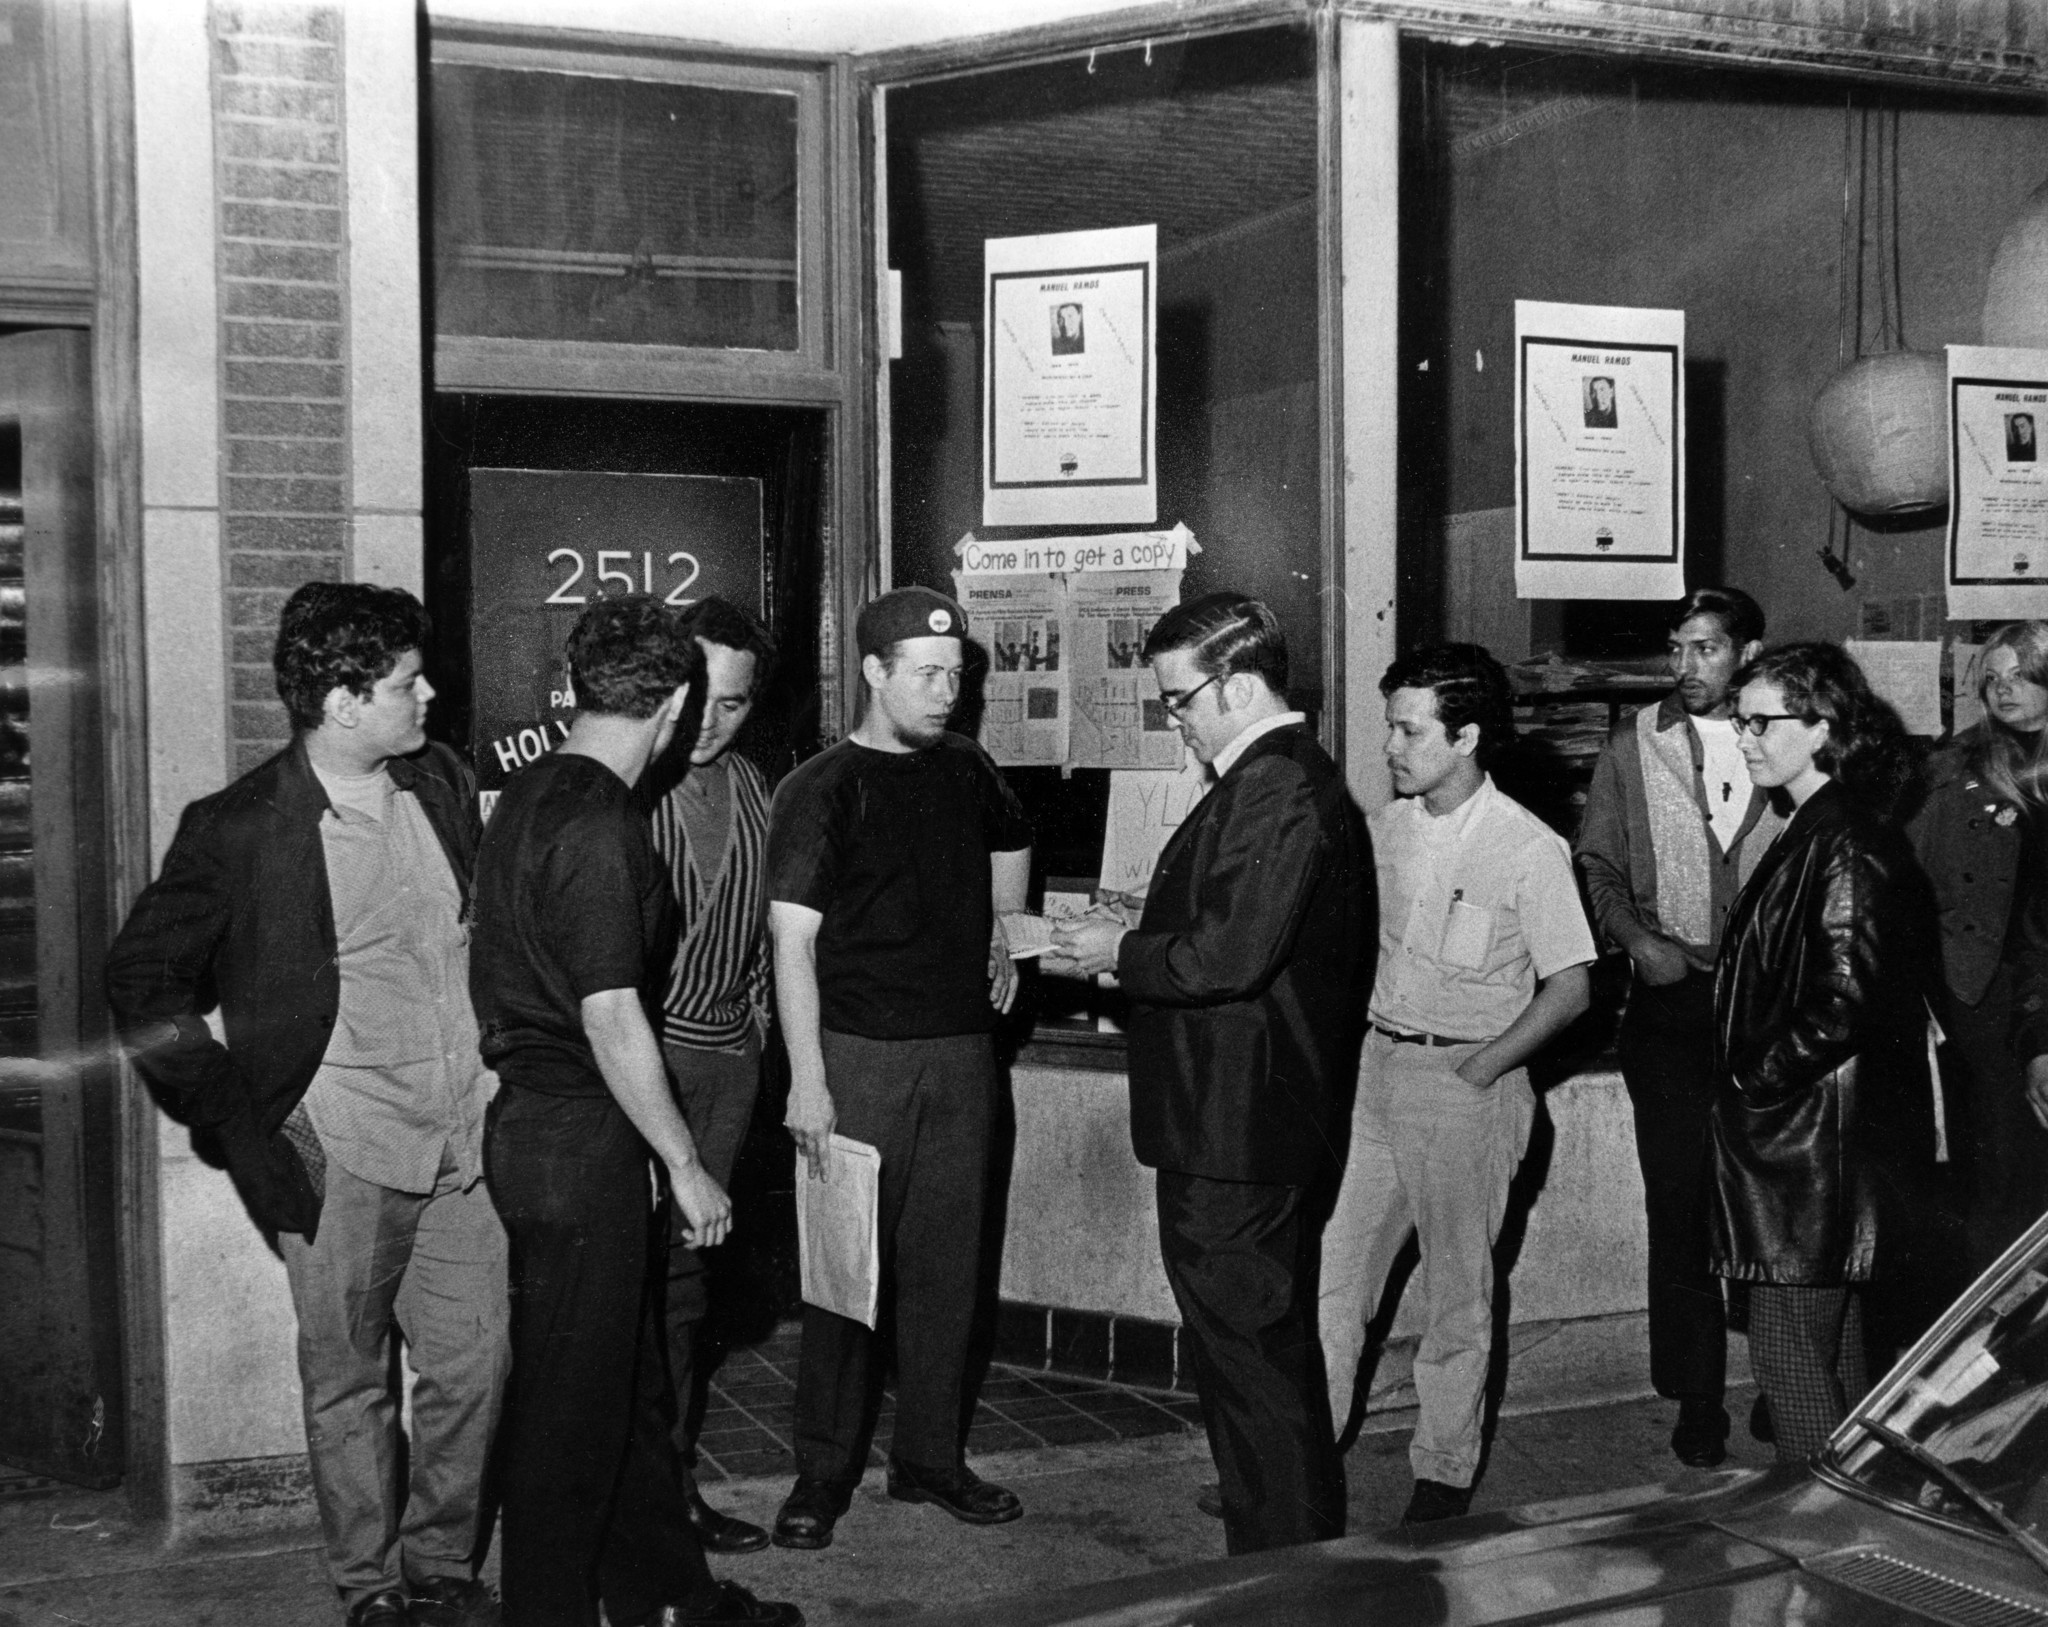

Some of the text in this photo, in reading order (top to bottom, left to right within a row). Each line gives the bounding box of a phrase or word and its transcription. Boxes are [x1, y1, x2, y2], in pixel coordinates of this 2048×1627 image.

[1040, 280, 1099, 291] MANUEL RAMOS
[1571, 354, 1631, 365] MANUEL RAMOS
[1995, 393, 2047, 403] MANUEL RAMOS
[966, 544, 1017, 571] Come
[1073, 546, 1106, 573] get
[1113, 549, 1124, 566] a
[1130, 543, 1176, 568] copy
[545, 548, 700, 606] 2512
[969, 590, 1013, 599] PRENSA
[1116, 587, 1152, 596] PRESS
